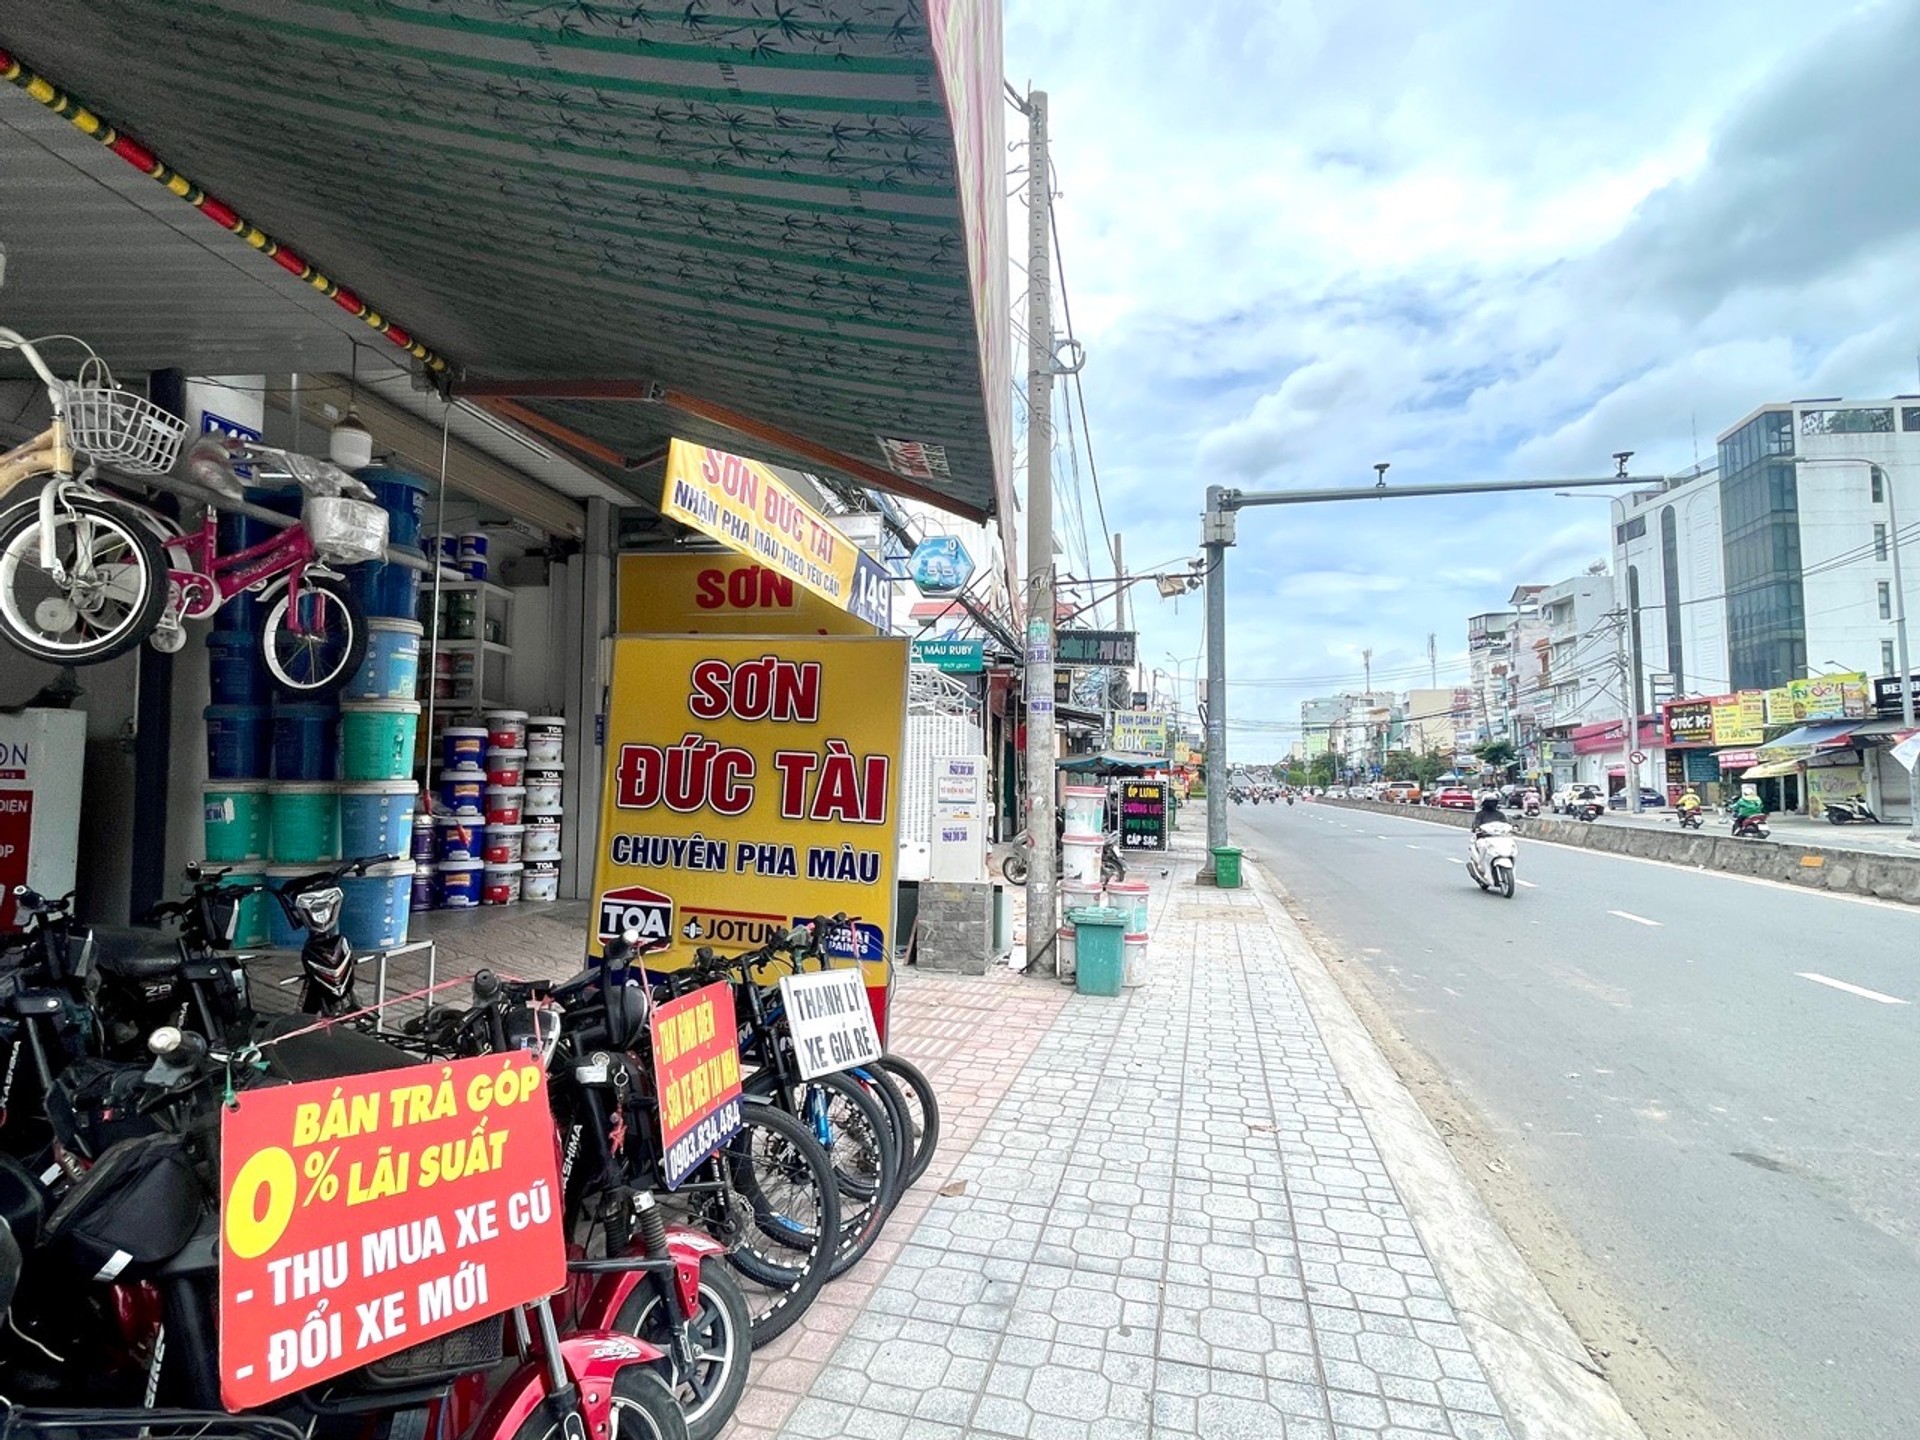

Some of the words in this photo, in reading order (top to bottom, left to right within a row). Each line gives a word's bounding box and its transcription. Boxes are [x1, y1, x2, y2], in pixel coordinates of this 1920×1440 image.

[702, 448, 758, 511] SƠN
[763, 485, 804, 543] ĐỨC
[674, 480, 719, 526] NHẬN
[721, 510, 750, 543] PHA
[782, 547, 804, 575] THEO
[695, 564, 793, 610] SƠN
[860, 566, 888, 618] 149
[949, 645, 974, 655] RUBY
[688, 655, 821, 722] SƠN
[616, 733, 756, 816] ĐỨC
[774, 740, 890, 824] TÀI
[537, 816, 555, 824] TOA
[536, 862, 554, 870] TOA
[611, 834, 728, 872] CHUYÊN
[735, 841, 798, 878] PHA
[807, 843, 880, 885] MÀU
[604, 905, 666, 937] TOA
[705, 919, 781, 944] JOTUN
[793, 984, 845, 1021] THANH
[804, 1035, 829, 1071] XE
[829, 1022, 856, 1065] GIÁ
[853, 1017, 873, 1057] RẺ
[293, 1086, 382, 1147] BÁN
[390, 1067, 458, 1128] TRẢ
[467, 1059, 541, 1112] GÓP
[346, 1146, 410, 1207] LÃI
[418, 1116, 509, 1187] SUẤT
[669, 1099, 741, 1181] 0903.834.484
[267, 1242, 348, 1306] THU
[361, 1216, 446, 1279] MUA
[454, 1200, 499, 1248] XE
[508, 1179, 551, 1231] CŨ
[268, 1298, 343, 1383] ĐỔI
[355, 1291, 406, 1350] XE
[418, 1260, 488, 1326] MỚI
